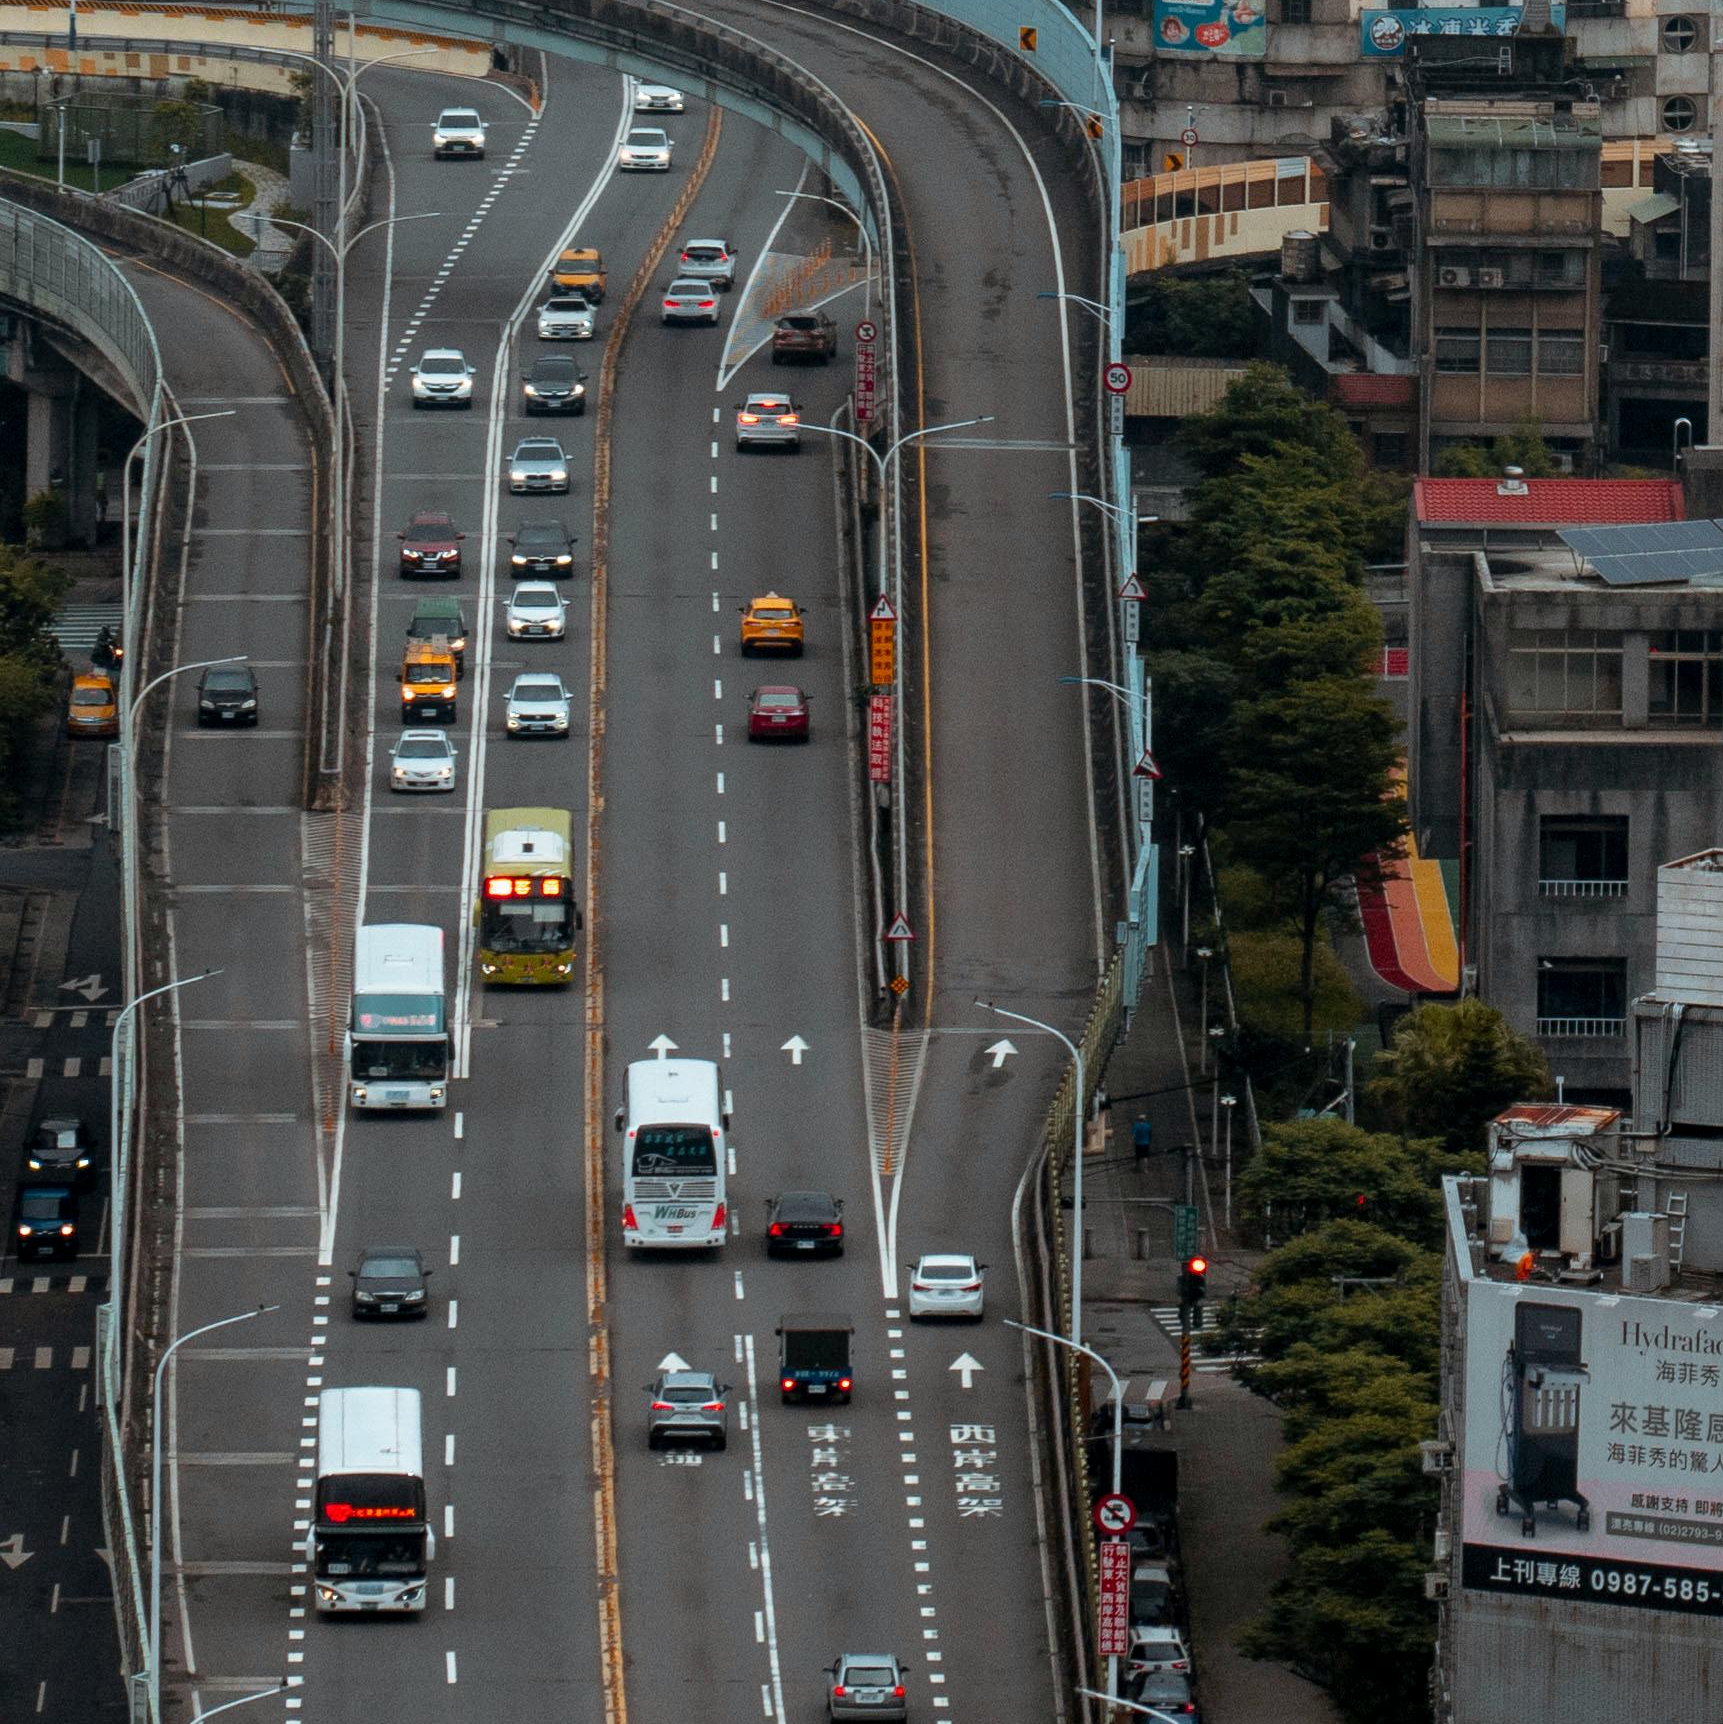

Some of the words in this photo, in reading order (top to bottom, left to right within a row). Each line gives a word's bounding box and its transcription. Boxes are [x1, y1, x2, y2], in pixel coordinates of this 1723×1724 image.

[1110, 372, 1126, 383] 50
[1656, 1360, 1720, 1388] 海菲秀
[950, 1424, 1003, 1517] 西岸高架
[1631, 1493, 1689, 1514] 感謝支持
[1490, 1557, 1581, 1589] 上刊專線
